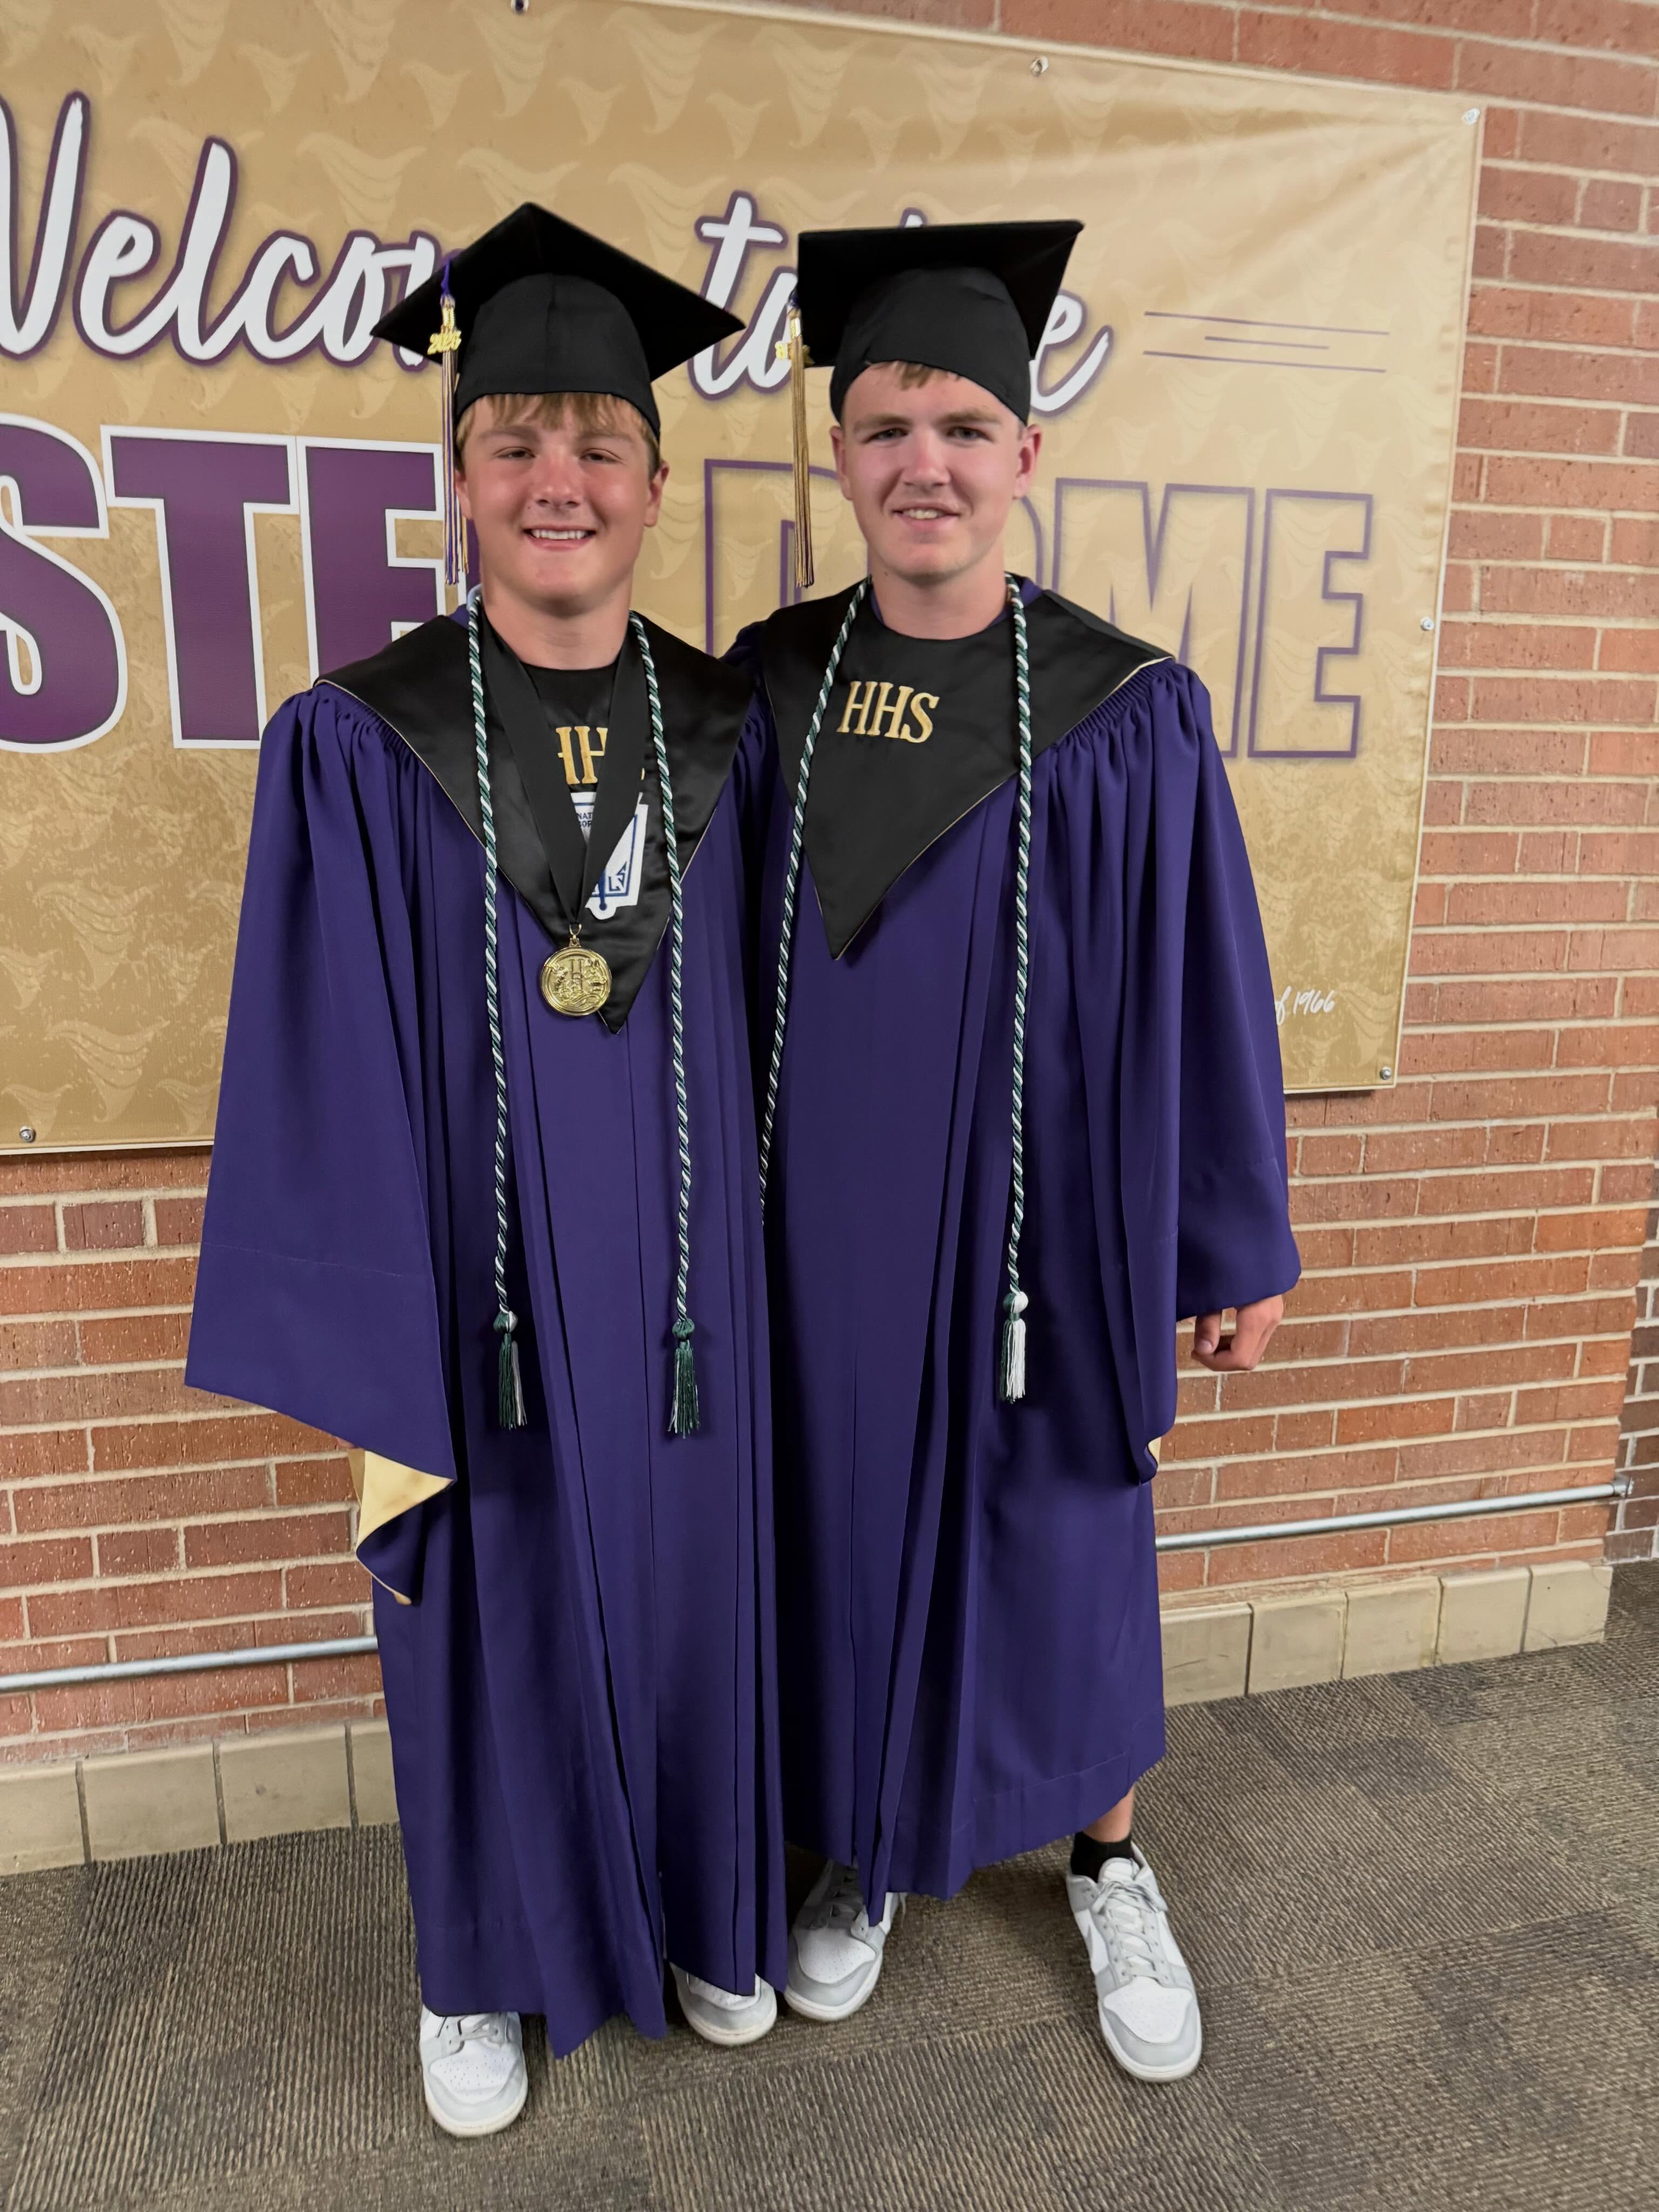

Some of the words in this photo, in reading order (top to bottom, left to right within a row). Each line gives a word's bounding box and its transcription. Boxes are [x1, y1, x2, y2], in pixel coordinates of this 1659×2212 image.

[704, 458, 1373, 758] DME
[837, 681, 940, 743] HHS
[1293, 989, 1335, 1015] 1966
